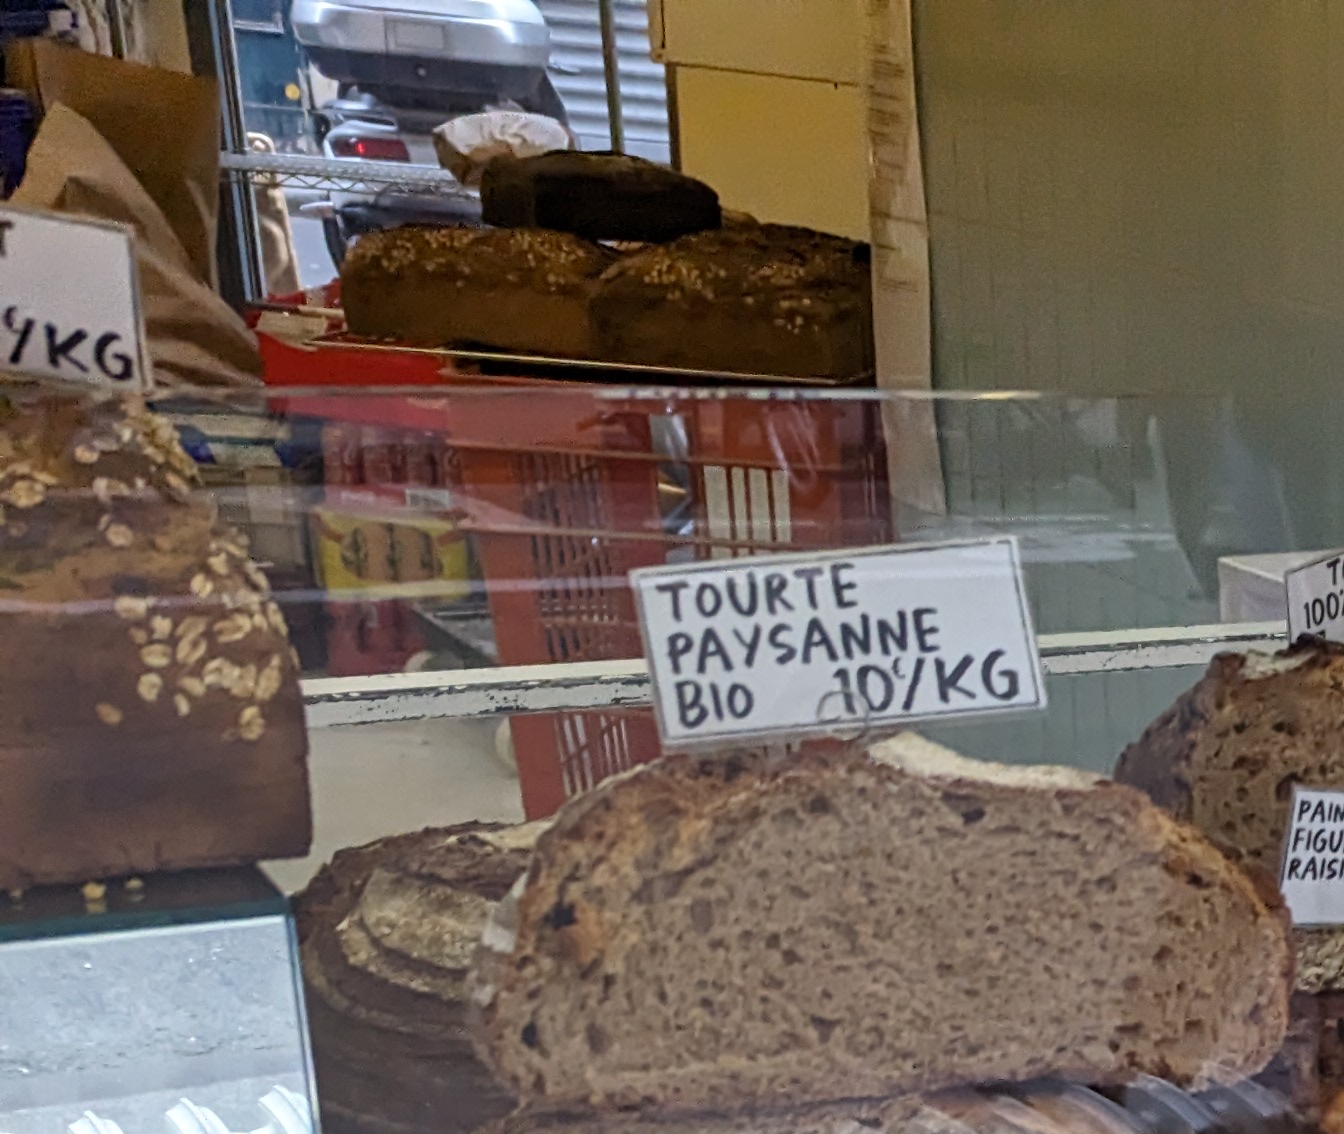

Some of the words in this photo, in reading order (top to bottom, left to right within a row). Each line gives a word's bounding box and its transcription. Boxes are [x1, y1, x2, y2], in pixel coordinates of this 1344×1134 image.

[656, 562, 859, 622] TOURTE
[667, 606, 941, 675] PAYSANNE
[675, 679, 754, 730] BIO
